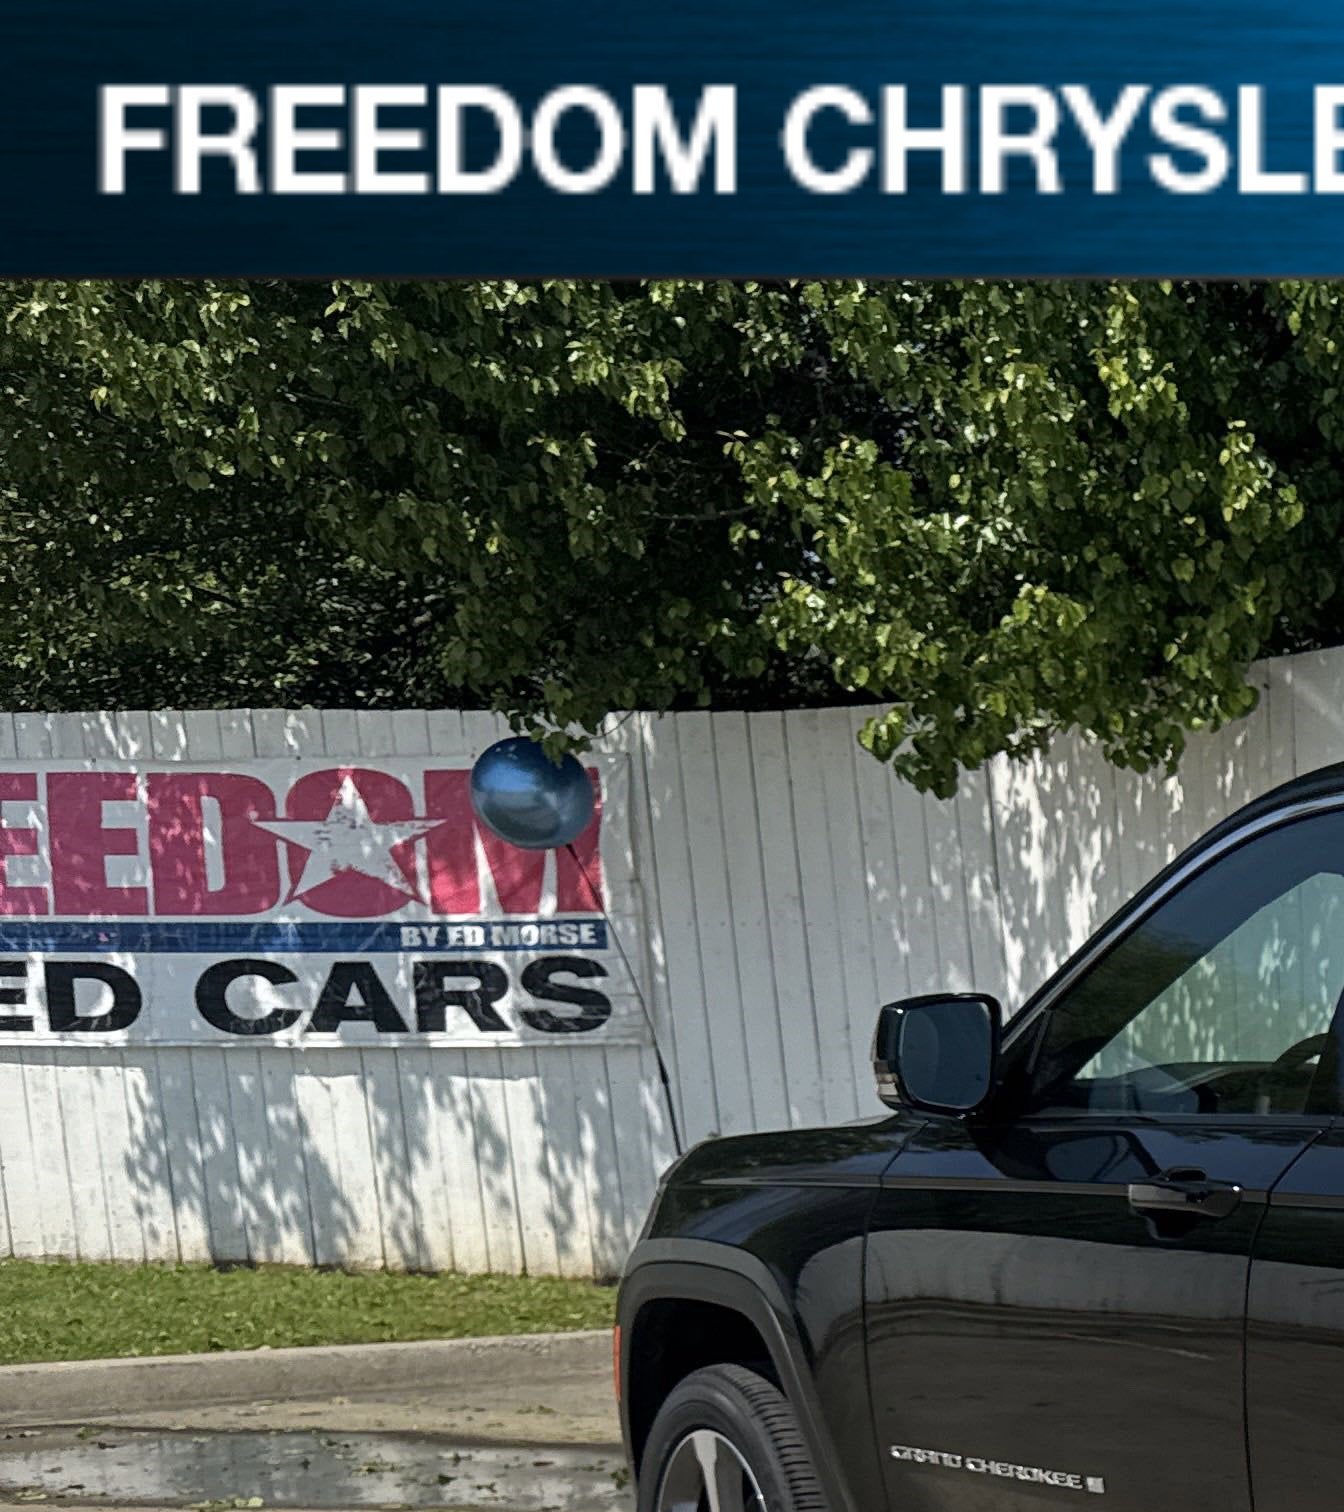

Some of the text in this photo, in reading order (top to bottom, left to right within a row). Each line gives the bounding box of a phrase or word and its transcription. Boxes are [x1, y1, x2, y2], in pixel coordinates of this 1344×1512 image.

[400, 922, 598, 947] BY ED MORSE
[195, 955, 612, 1035] CARS
[890, 1445, 1083, 1489] GRAND CHEROKEE
